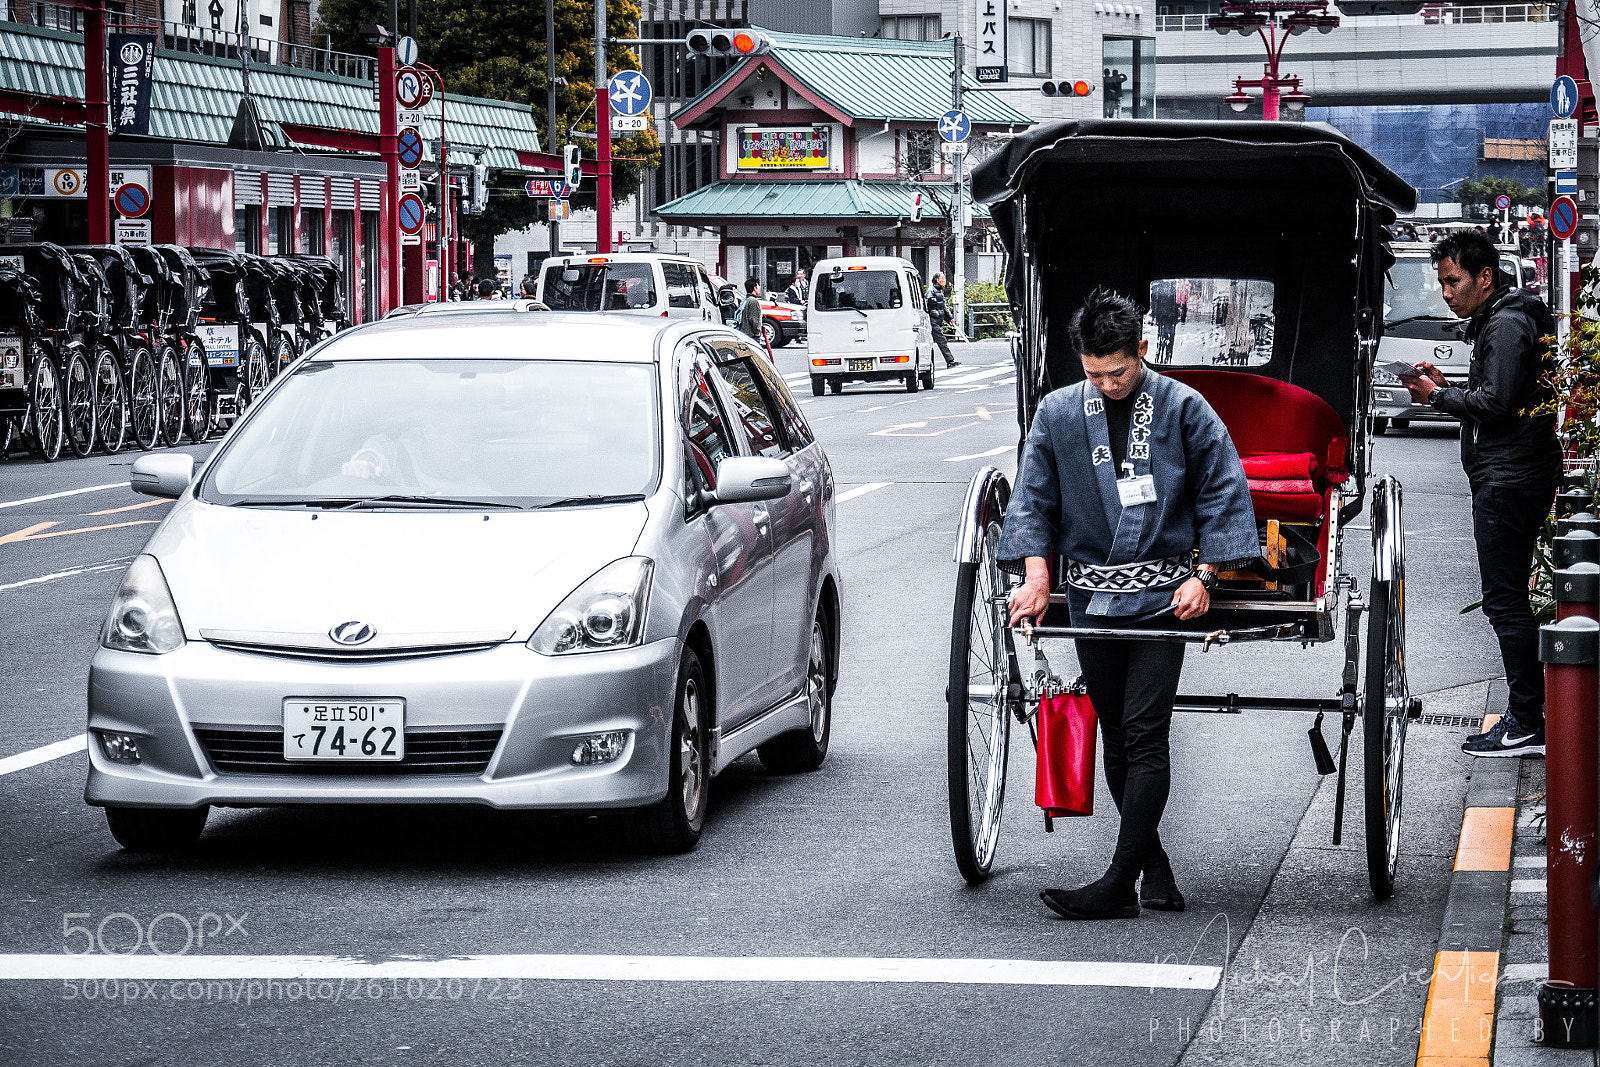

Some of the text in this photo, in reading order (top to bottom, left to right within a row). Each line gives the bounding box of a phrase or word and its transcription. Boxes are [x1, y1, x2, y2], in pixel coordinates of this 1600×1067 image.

[120, 66, 139, 126] 三社祭
[554, 180, 561, 191] 6
[1129, 392, 1154, 460] えびす屋
[292, 726, 397, 756] て 74-62
